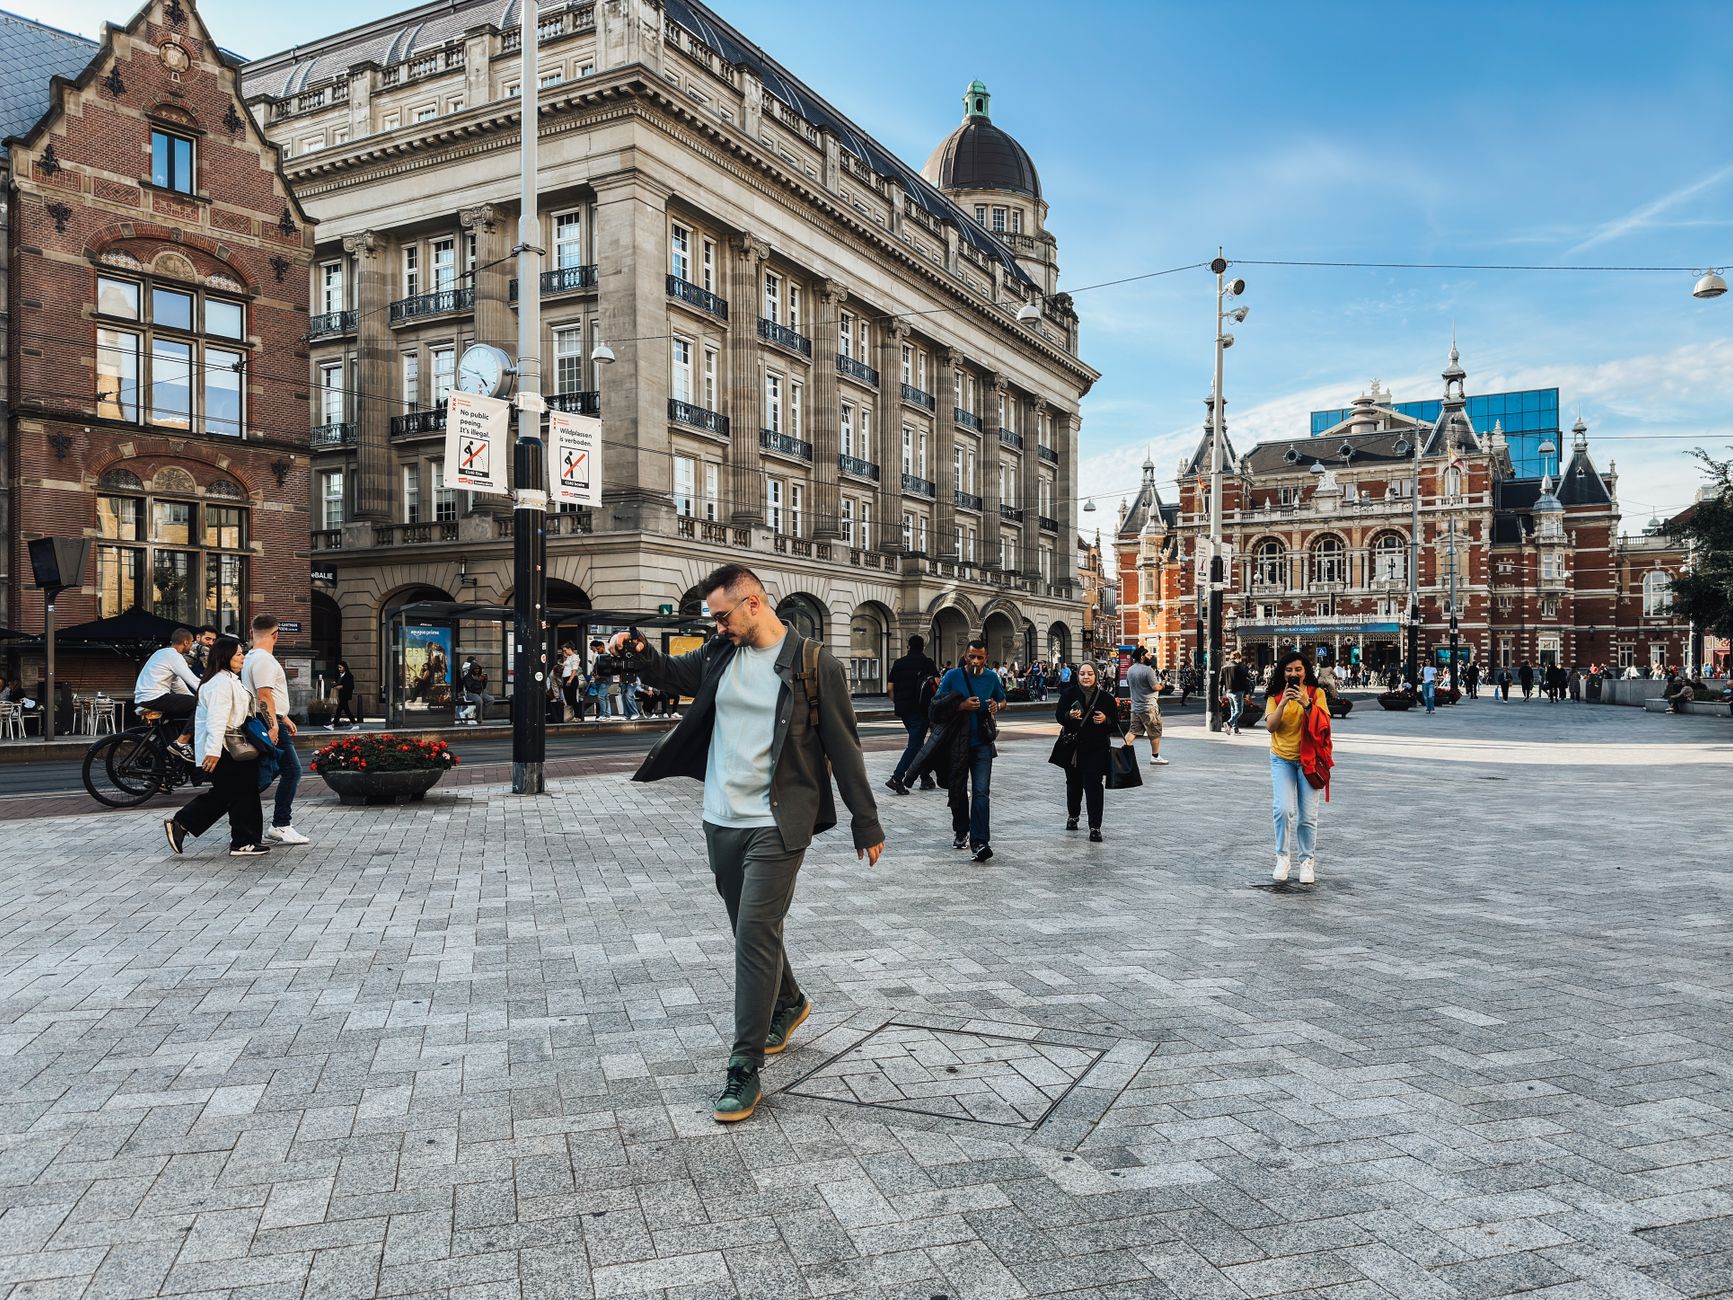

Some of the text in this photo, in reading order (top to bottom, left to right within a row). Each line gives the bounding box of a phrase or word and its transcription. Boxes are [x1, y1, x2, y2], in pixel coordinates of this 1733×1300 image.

[470, 412, 489, 420] public
[460, 419, 482, 428] peeing.
[470, 428, 490, 438] illegal.
[560, 428, 592, 439] Wildplassen
[565, 437, 592, 447] verboden.
